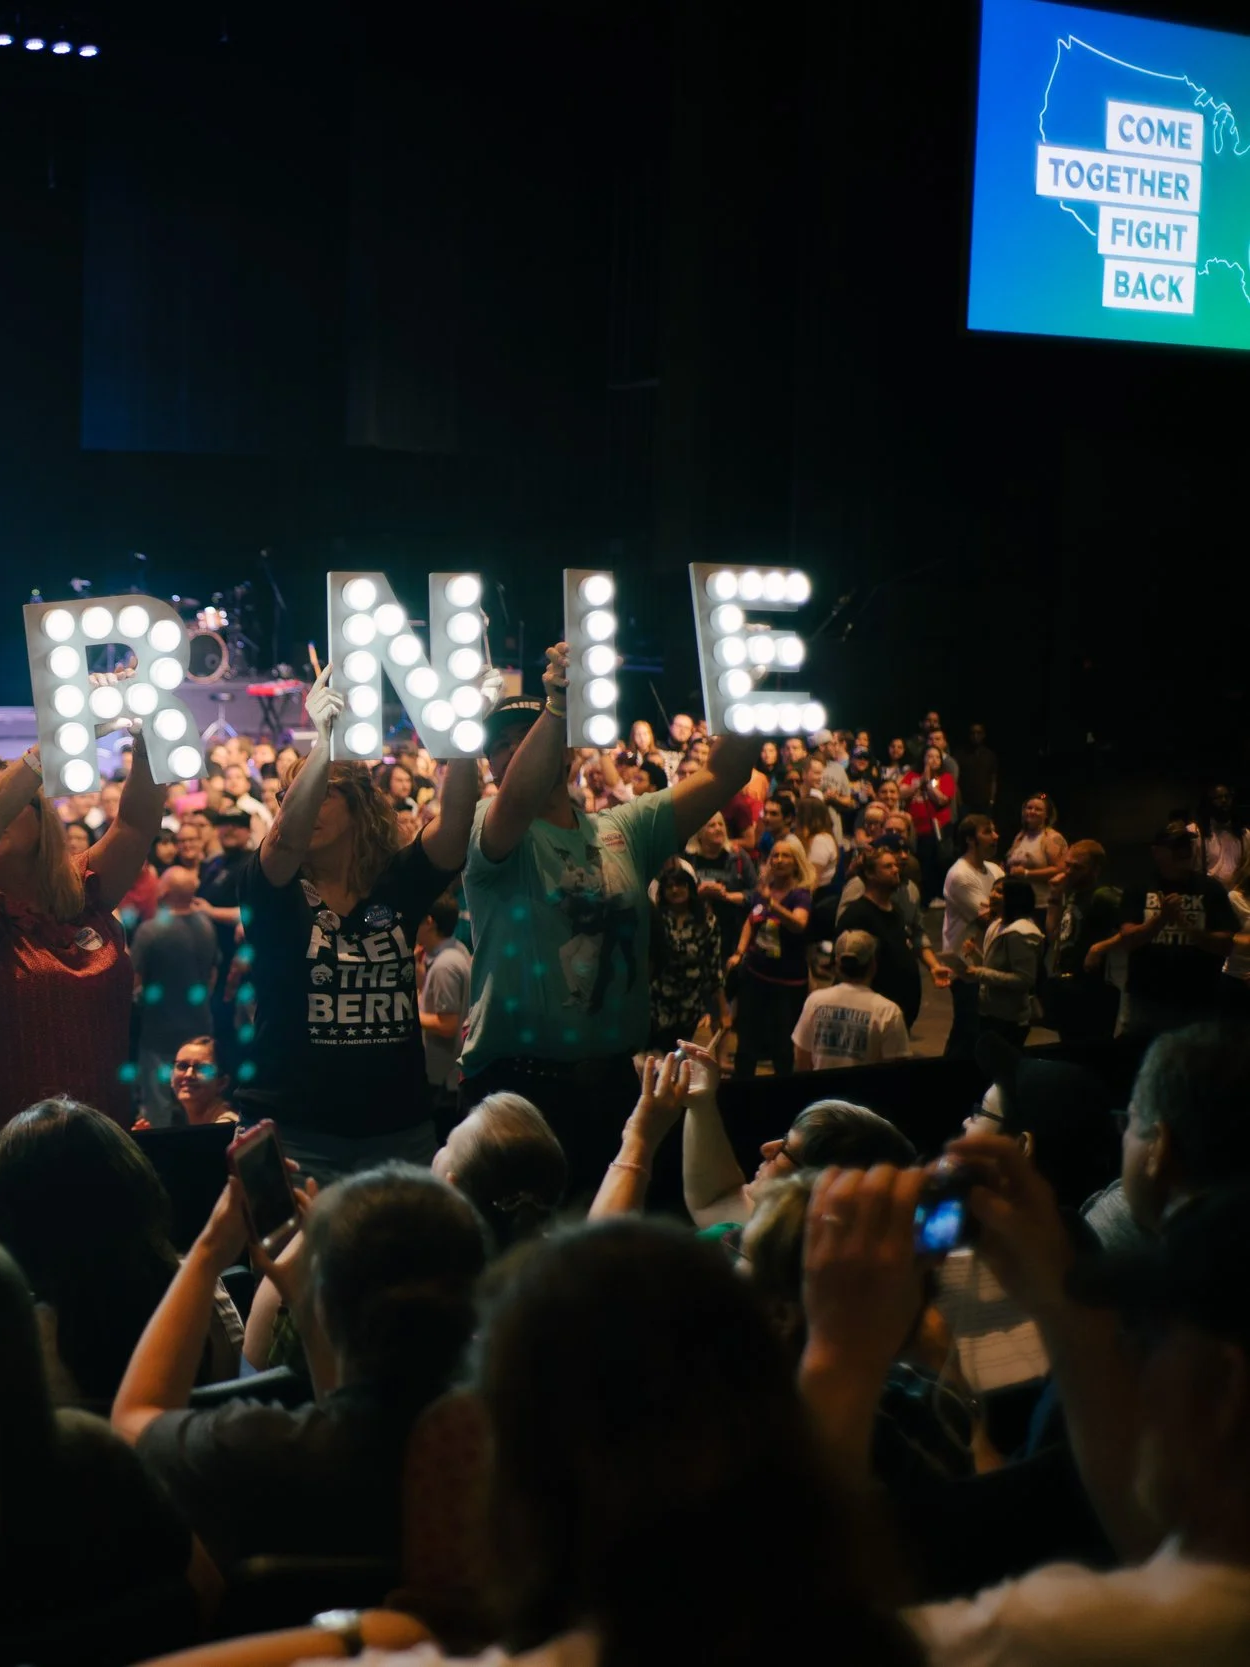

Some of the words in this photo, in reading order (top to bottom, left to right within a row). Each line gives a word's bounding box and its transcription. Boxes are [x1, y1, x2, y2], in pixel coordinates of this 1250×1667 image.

[1118, 114, 1193, 150] COME
[1048, 158, 1190, 201] TOGETHER
[1110, 218, 1187, 252] FIGHT
[1113, 270, 1184, 303] BACK
[306, 924, 415, 962] FEEL
[336, 963, 400, 988] THE
[307, 991, 415, 1024] BERN
